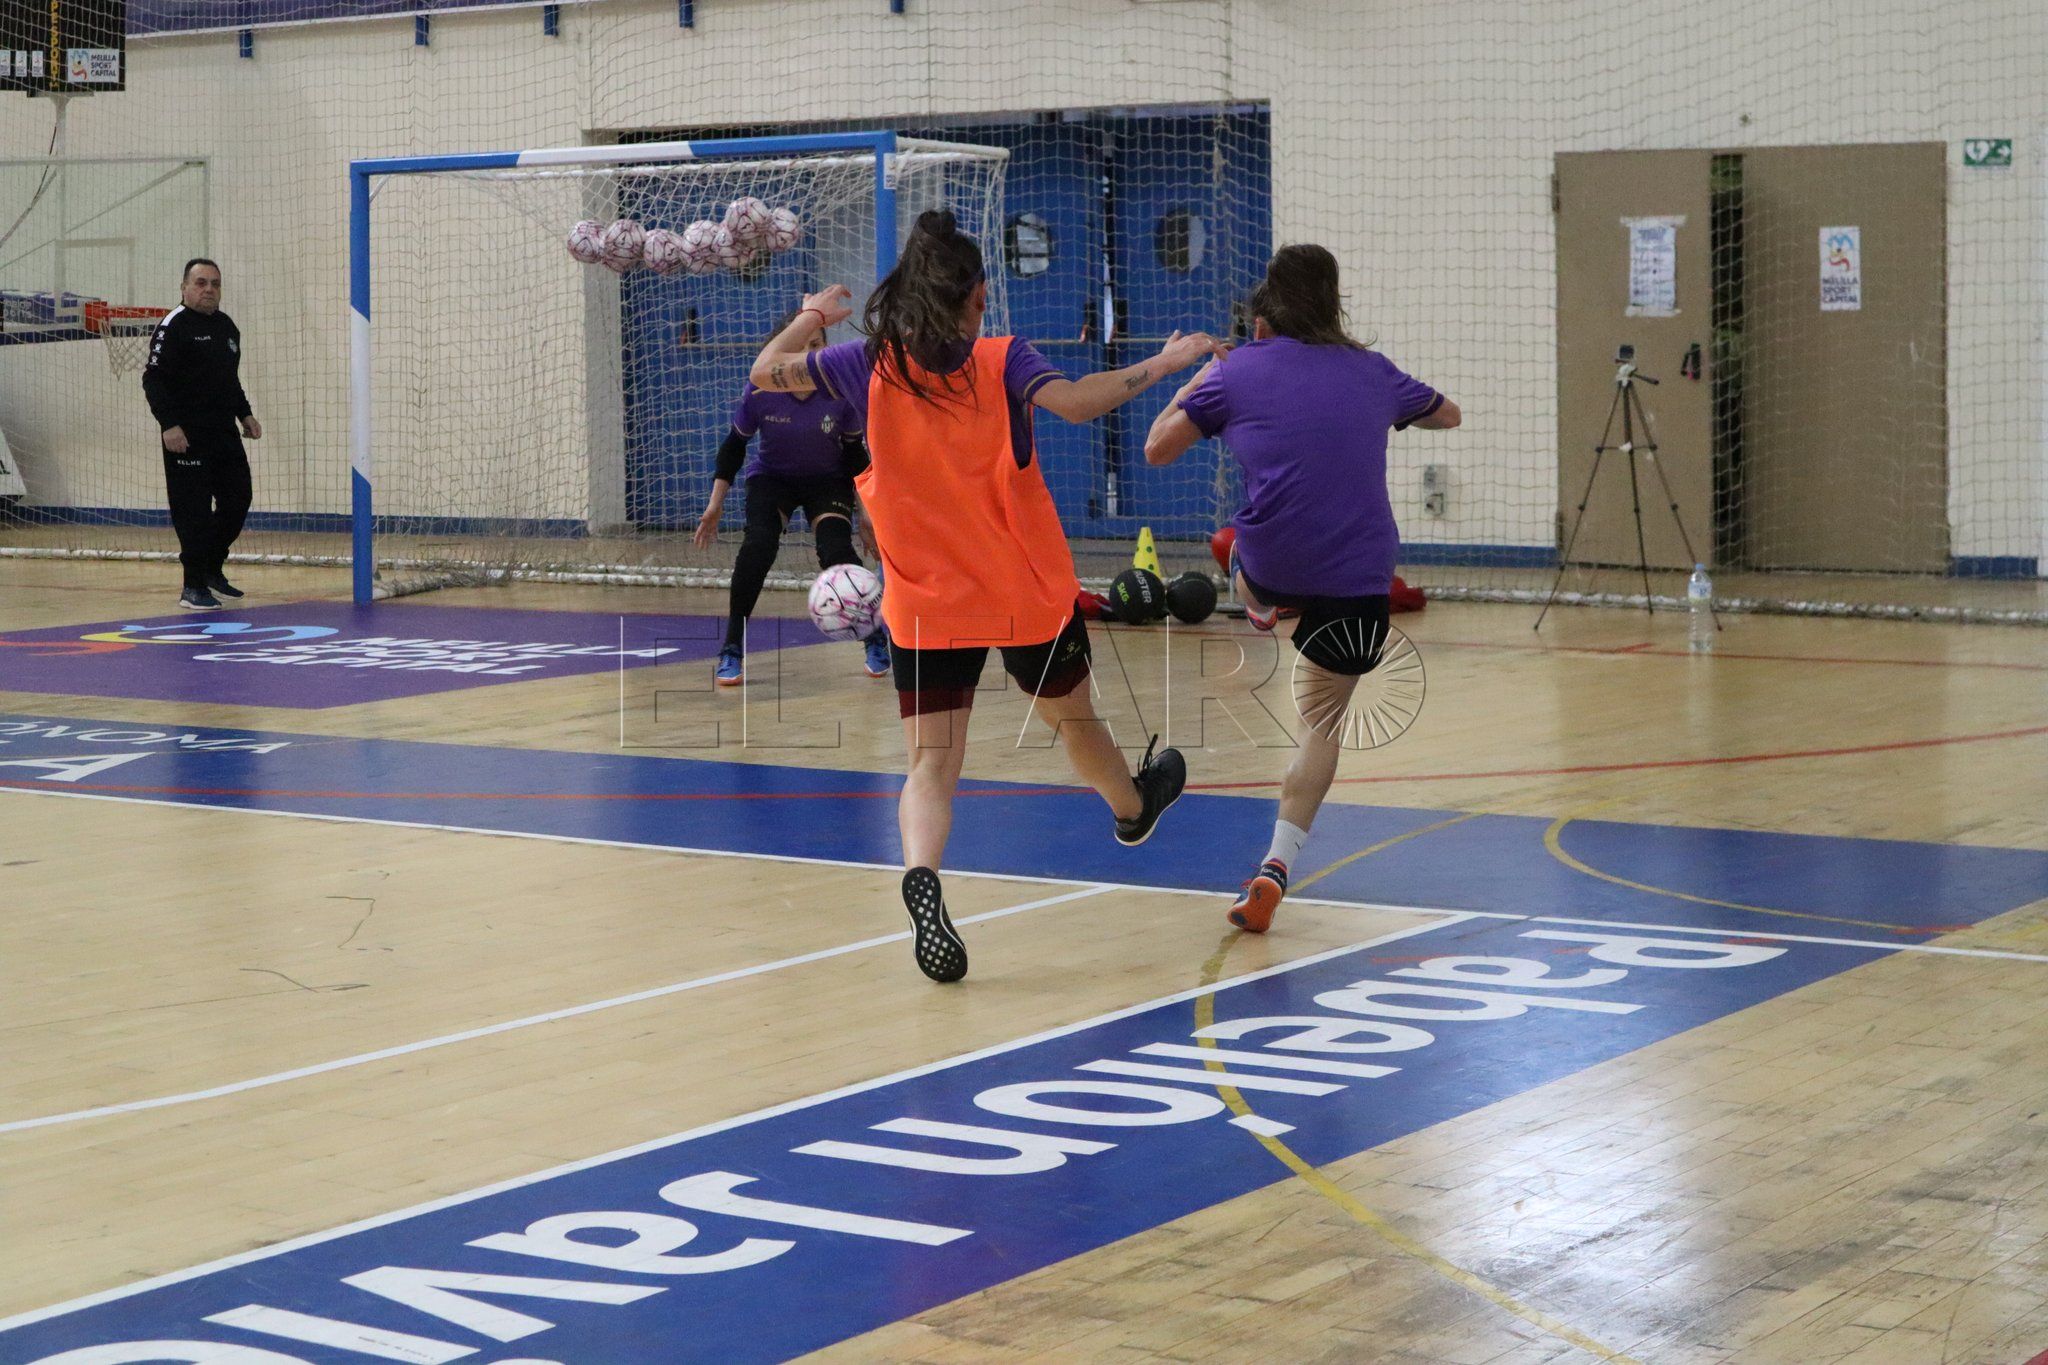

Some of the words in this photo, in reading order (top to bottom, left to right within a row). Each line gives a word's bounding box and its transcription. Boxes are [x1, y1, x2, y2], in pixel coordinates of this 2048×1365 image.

[91, 54, 117, 62] MELILLA
[91, 69, 117, 77] CAPITAL
[1822, 277, 1858, 285] MELILLA
